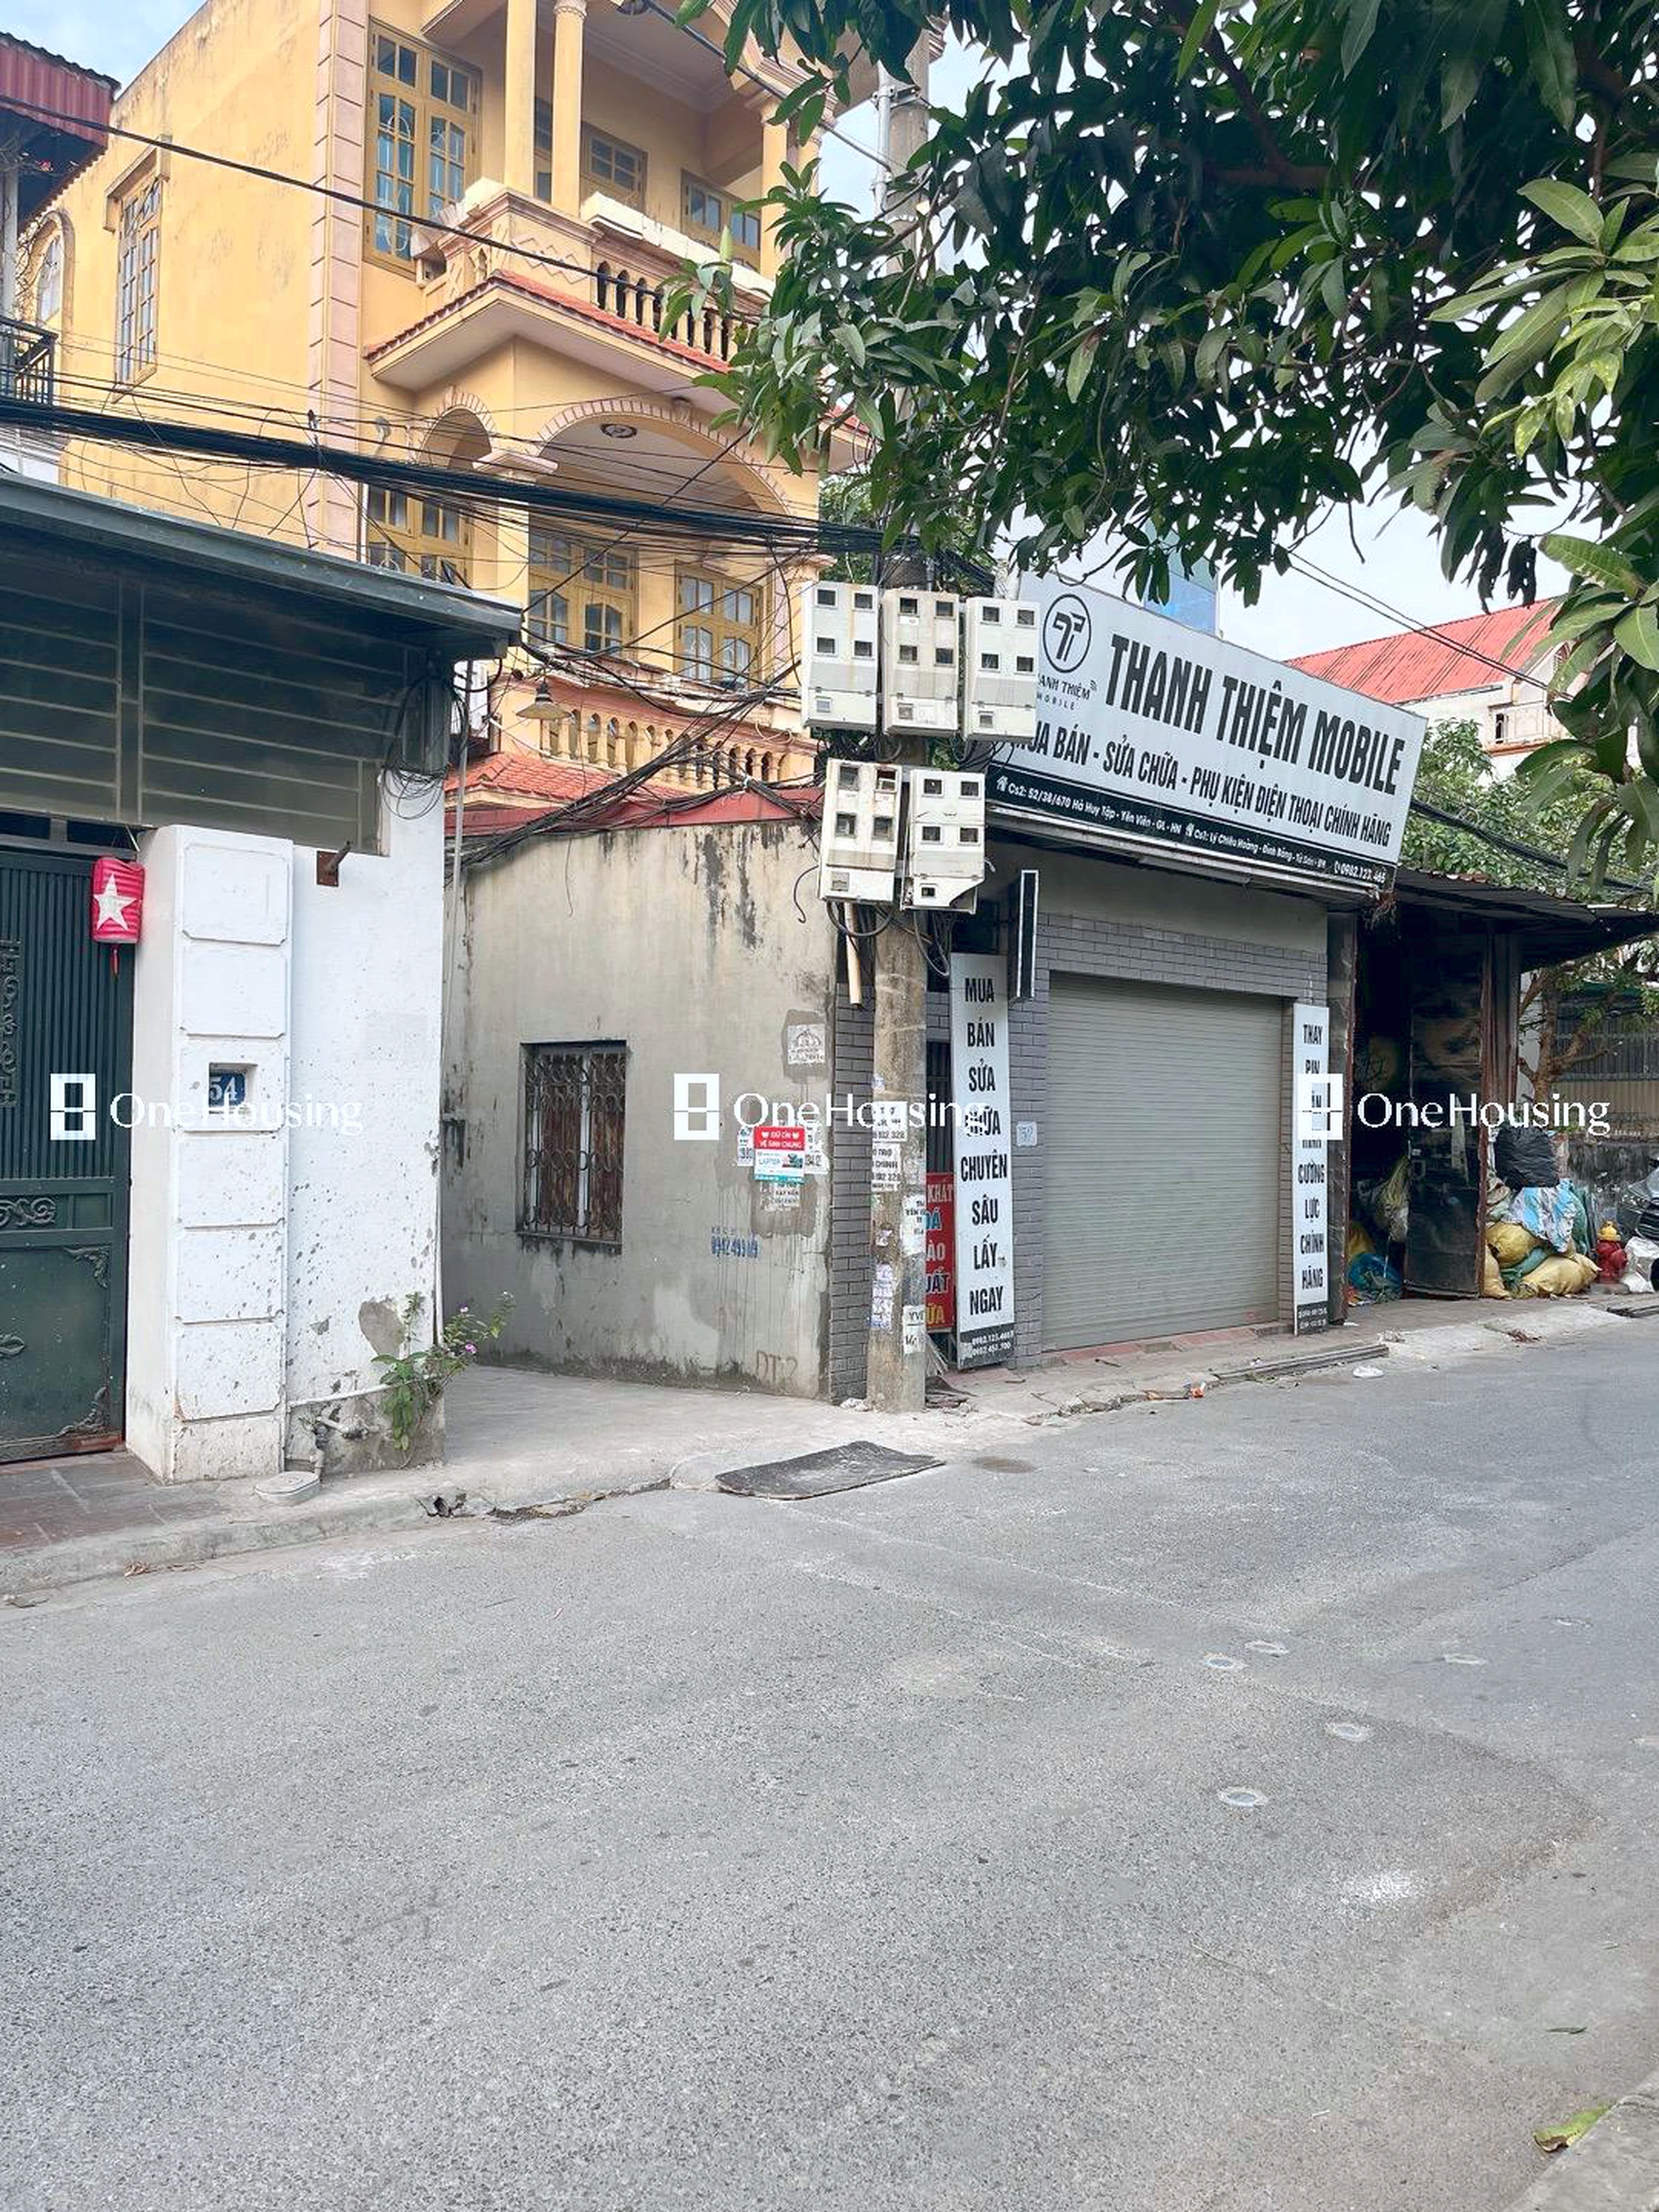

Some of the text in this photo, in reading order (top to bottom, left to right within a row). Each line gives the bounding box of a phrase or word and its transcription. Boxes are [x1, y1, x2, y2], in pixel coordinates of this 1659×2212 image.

[1105, 633, 1406, 796] THANH THIỆM MOBILE
[1053, 724, 1092, 766] BÁN
[1103, 734, 1137, 778] SỬA
[1137, 751, 1180, 791] CHỮA
[1190, 766, 1221, 808] PHỤ
[1220, 774, 1255, 814] KIỆN
[1255, 783, 1289, 822] ĐIỆN
[1288, 794, 1325, 833] THOẠI
[1324, 803, 1362, 841] CHÍNH
[965, 978, 995, 1003] MUA
[967, 1017, 995, 1048] BÁN
[1303, 1024, 1323, 1045] THAY
[208, 1076, 238, 1102] 54
[968, 1058, 996, 1093] SỬA
[960, 1149, 1008, 1182] CHUYÊN
[928, 1178, 953, 1203] KHÁT
[972, 1194, 998, 1226] SÂU
[1305, 1197, 1320, 1223] LỰC
[973, 1234, 997, 1270] LẤY
[1301, 1230, 1325, 1254] CHÍNH
[970, 1285, 1004, 1315] NGAY
